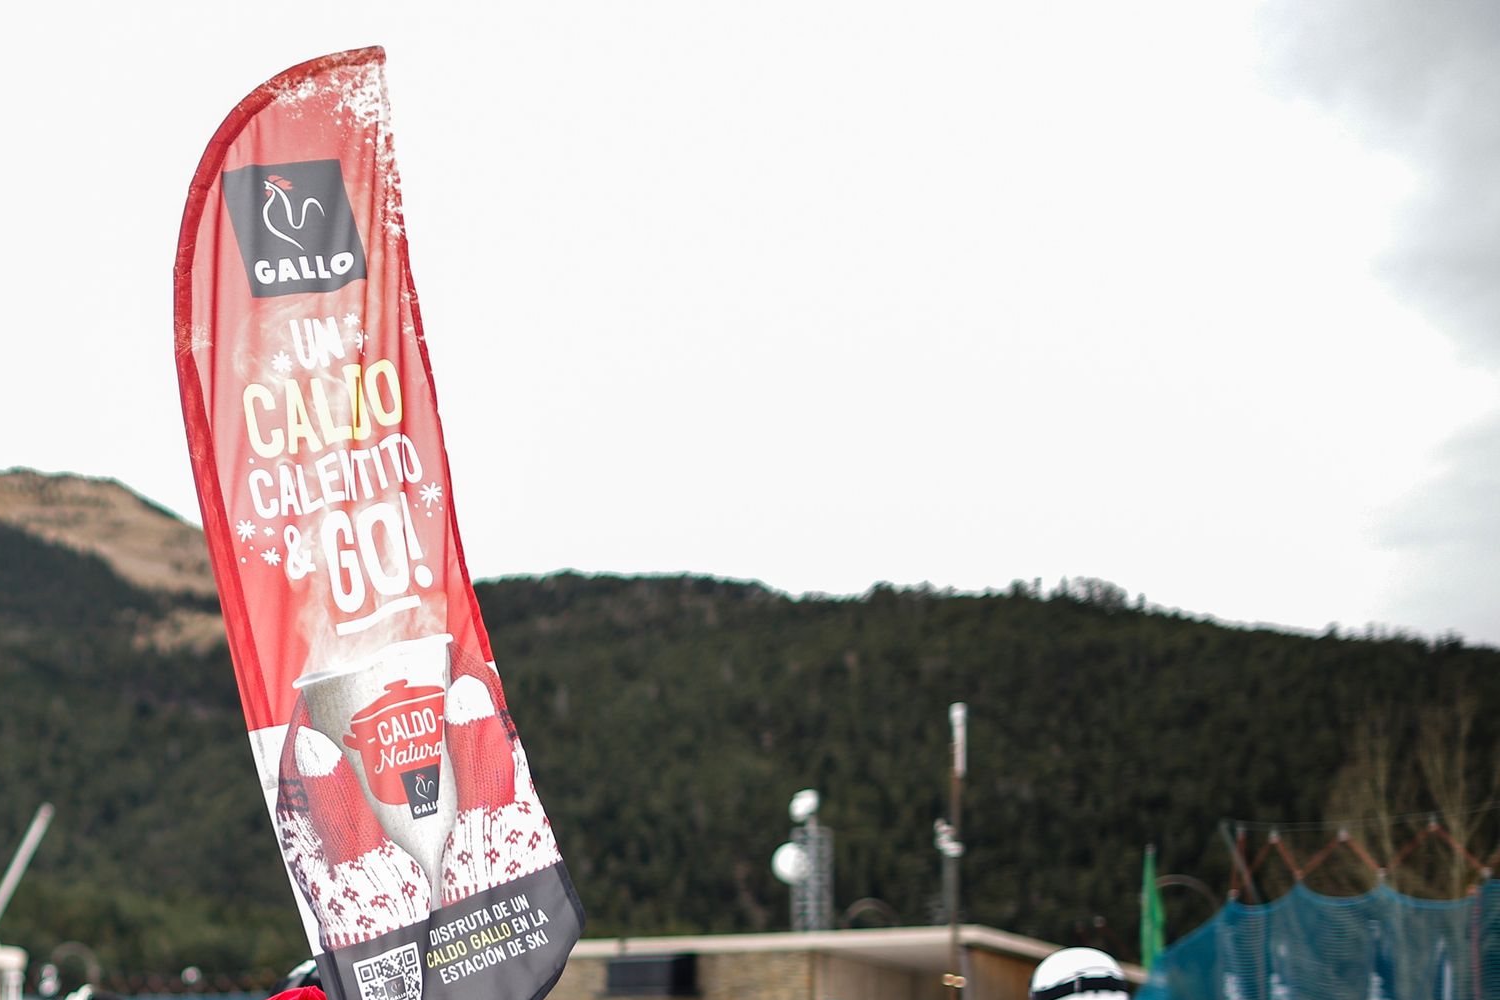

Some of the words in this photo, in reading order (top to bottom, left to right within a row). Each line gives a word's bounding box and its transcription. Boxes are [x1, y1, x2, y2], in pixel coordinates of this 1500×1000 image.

[254, 251, 354, 285] GALLO
[289, 316, 346, 370] UN
[243, 358, 403, 459] CALDO
[248, 432, 424, 519] CALENTITO
[283, 524, 316, 580] &
[320, 491, 434, 613] GO!
[377, 707, 437, 746] CALDO
[374, 740, 443, 775] Natura
[426, 940, 468, 968] CALDO
[469, 922, 512, 950] GALLO
[511, 915, 530, 935] EN
[529, 908, 549, 927] LA
[429, 907, 493, 946] DISFRUTA
[491, 901, 512, 921] DE
[510, 893, 530, 913] UN
[439, 945, 507, 985] ESTACIÓN
[506, 938, 527, 957] DE
[525, 929, 549, 950] SKI
